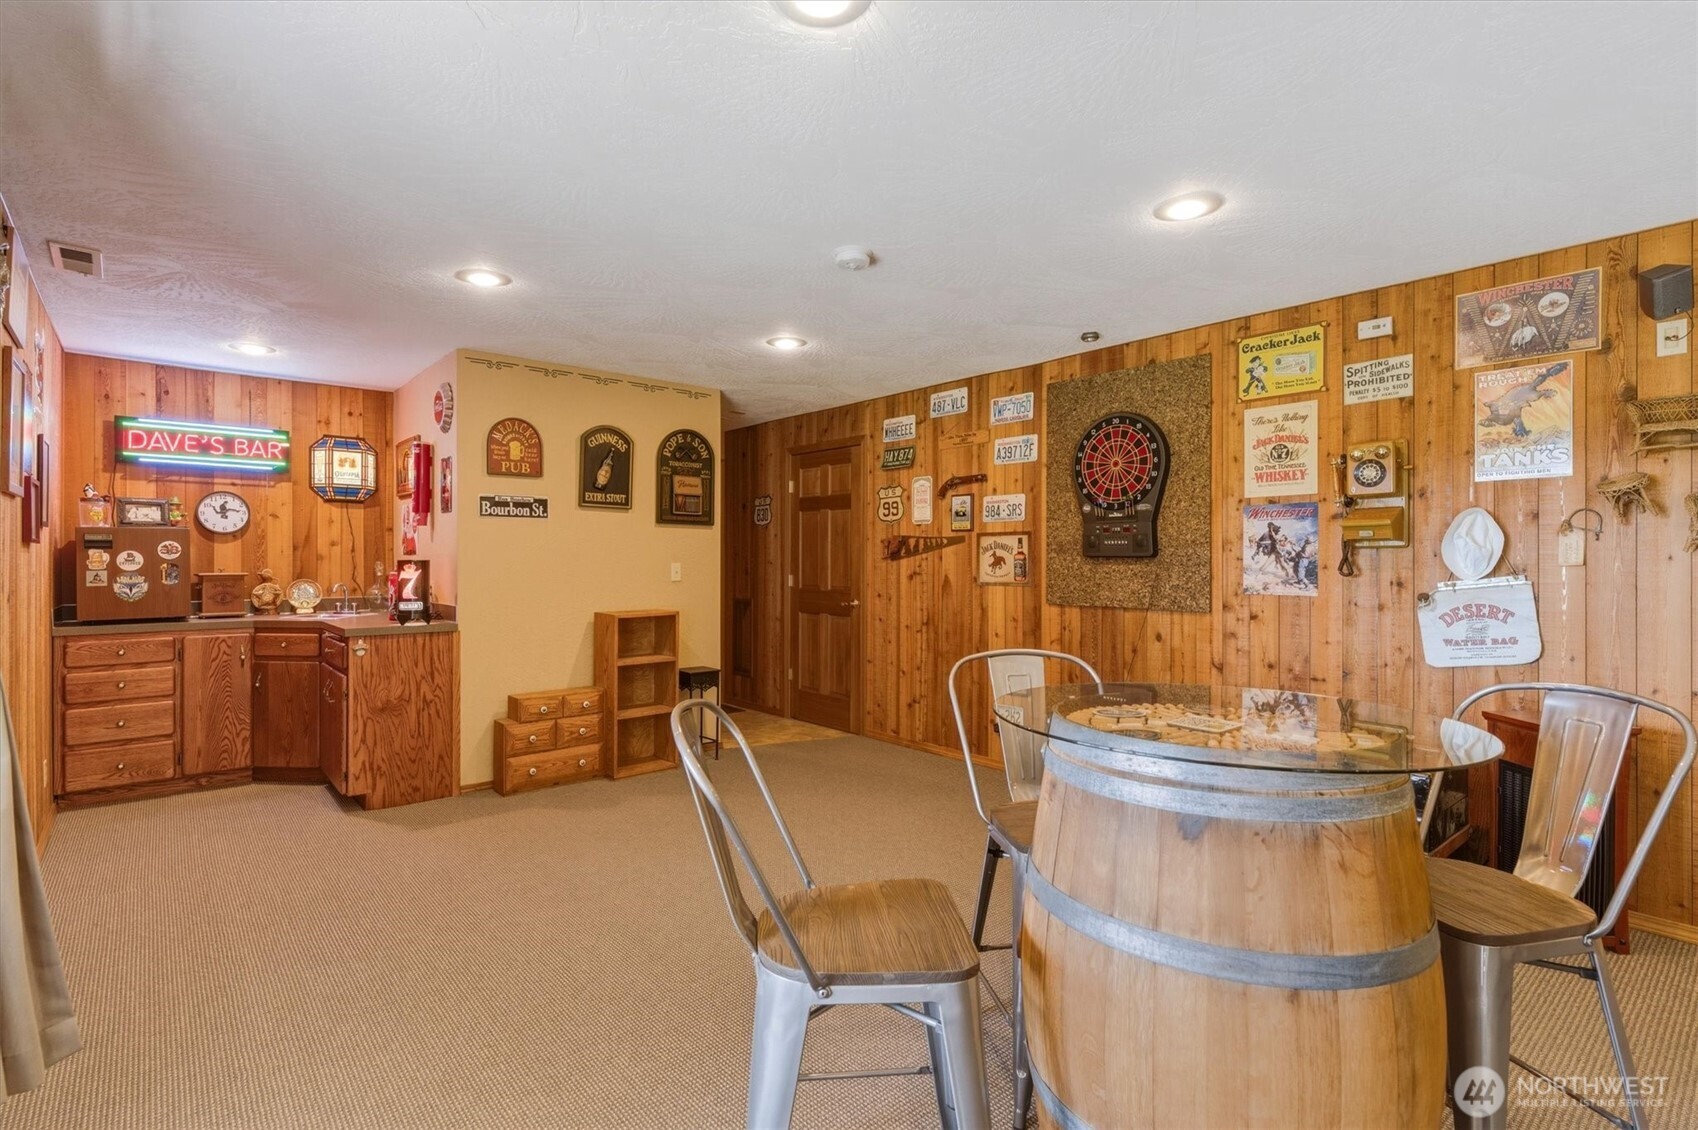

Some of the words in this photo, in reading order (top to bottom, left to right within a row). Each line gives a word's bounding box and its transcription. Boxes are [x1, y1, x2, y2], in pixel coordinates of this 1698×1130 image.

[1478, 276, 1574, 304] WINCHESTER
[1242, 338, 1289, 354] Cracker
[1290, 330, 1321, 346] Jack
[1346, 360, 1389, 378] SPITTING
[1369, 360, 1410, 377] SIDEWALKS
[1479, 370, 1520, 381] TREAT
[1347, 373, 1410, 389] PROHIBITED
[1282, 412, 1308, 424] Nothing
[492, 421, 539, 444] MEDACK'S
[885, 423, 913, 439] WHHEEEE
[1271, 424, 1287, 433] Like
[128, 429, 224, 456] DAVE'S
[234, 438, 283, 460] BAR
[588, 433, 628, 452] GUINNESS
[663, 434, 684, 458] POPE
[692, 438, 710, 459] SON
[1253, 436, 1275, 450] JACK
[1275, 434, 1309, 444] DANIEL'S
[996, 443, 1034, 460] A39712F
[1480, 447, 1569, 468] TANKS
[501, 461, 530, 473] PUB
[669, 460, 703, 468] TOBACCONIST
[1254, 469, 1307, 483] WHISKEY
[585, 492, 605, 502] EXTRA
[606, 494, 626, 503] STOUT
[481, 501, 530, 516] Bourbon
[532, 503, 547, 517] St.
[882, 501, 899, 517] 99
[1248, 507, 1314, 519] WINCHESTER
[981, 542, 993, 555] JACK
[993, 540, 1014, 554] DANIEL'S
[1438, 603, 1515, 628] DESERT
[1443, 638, 1487, 647] WATER
[1491, 637, 1518, 646] BAG
